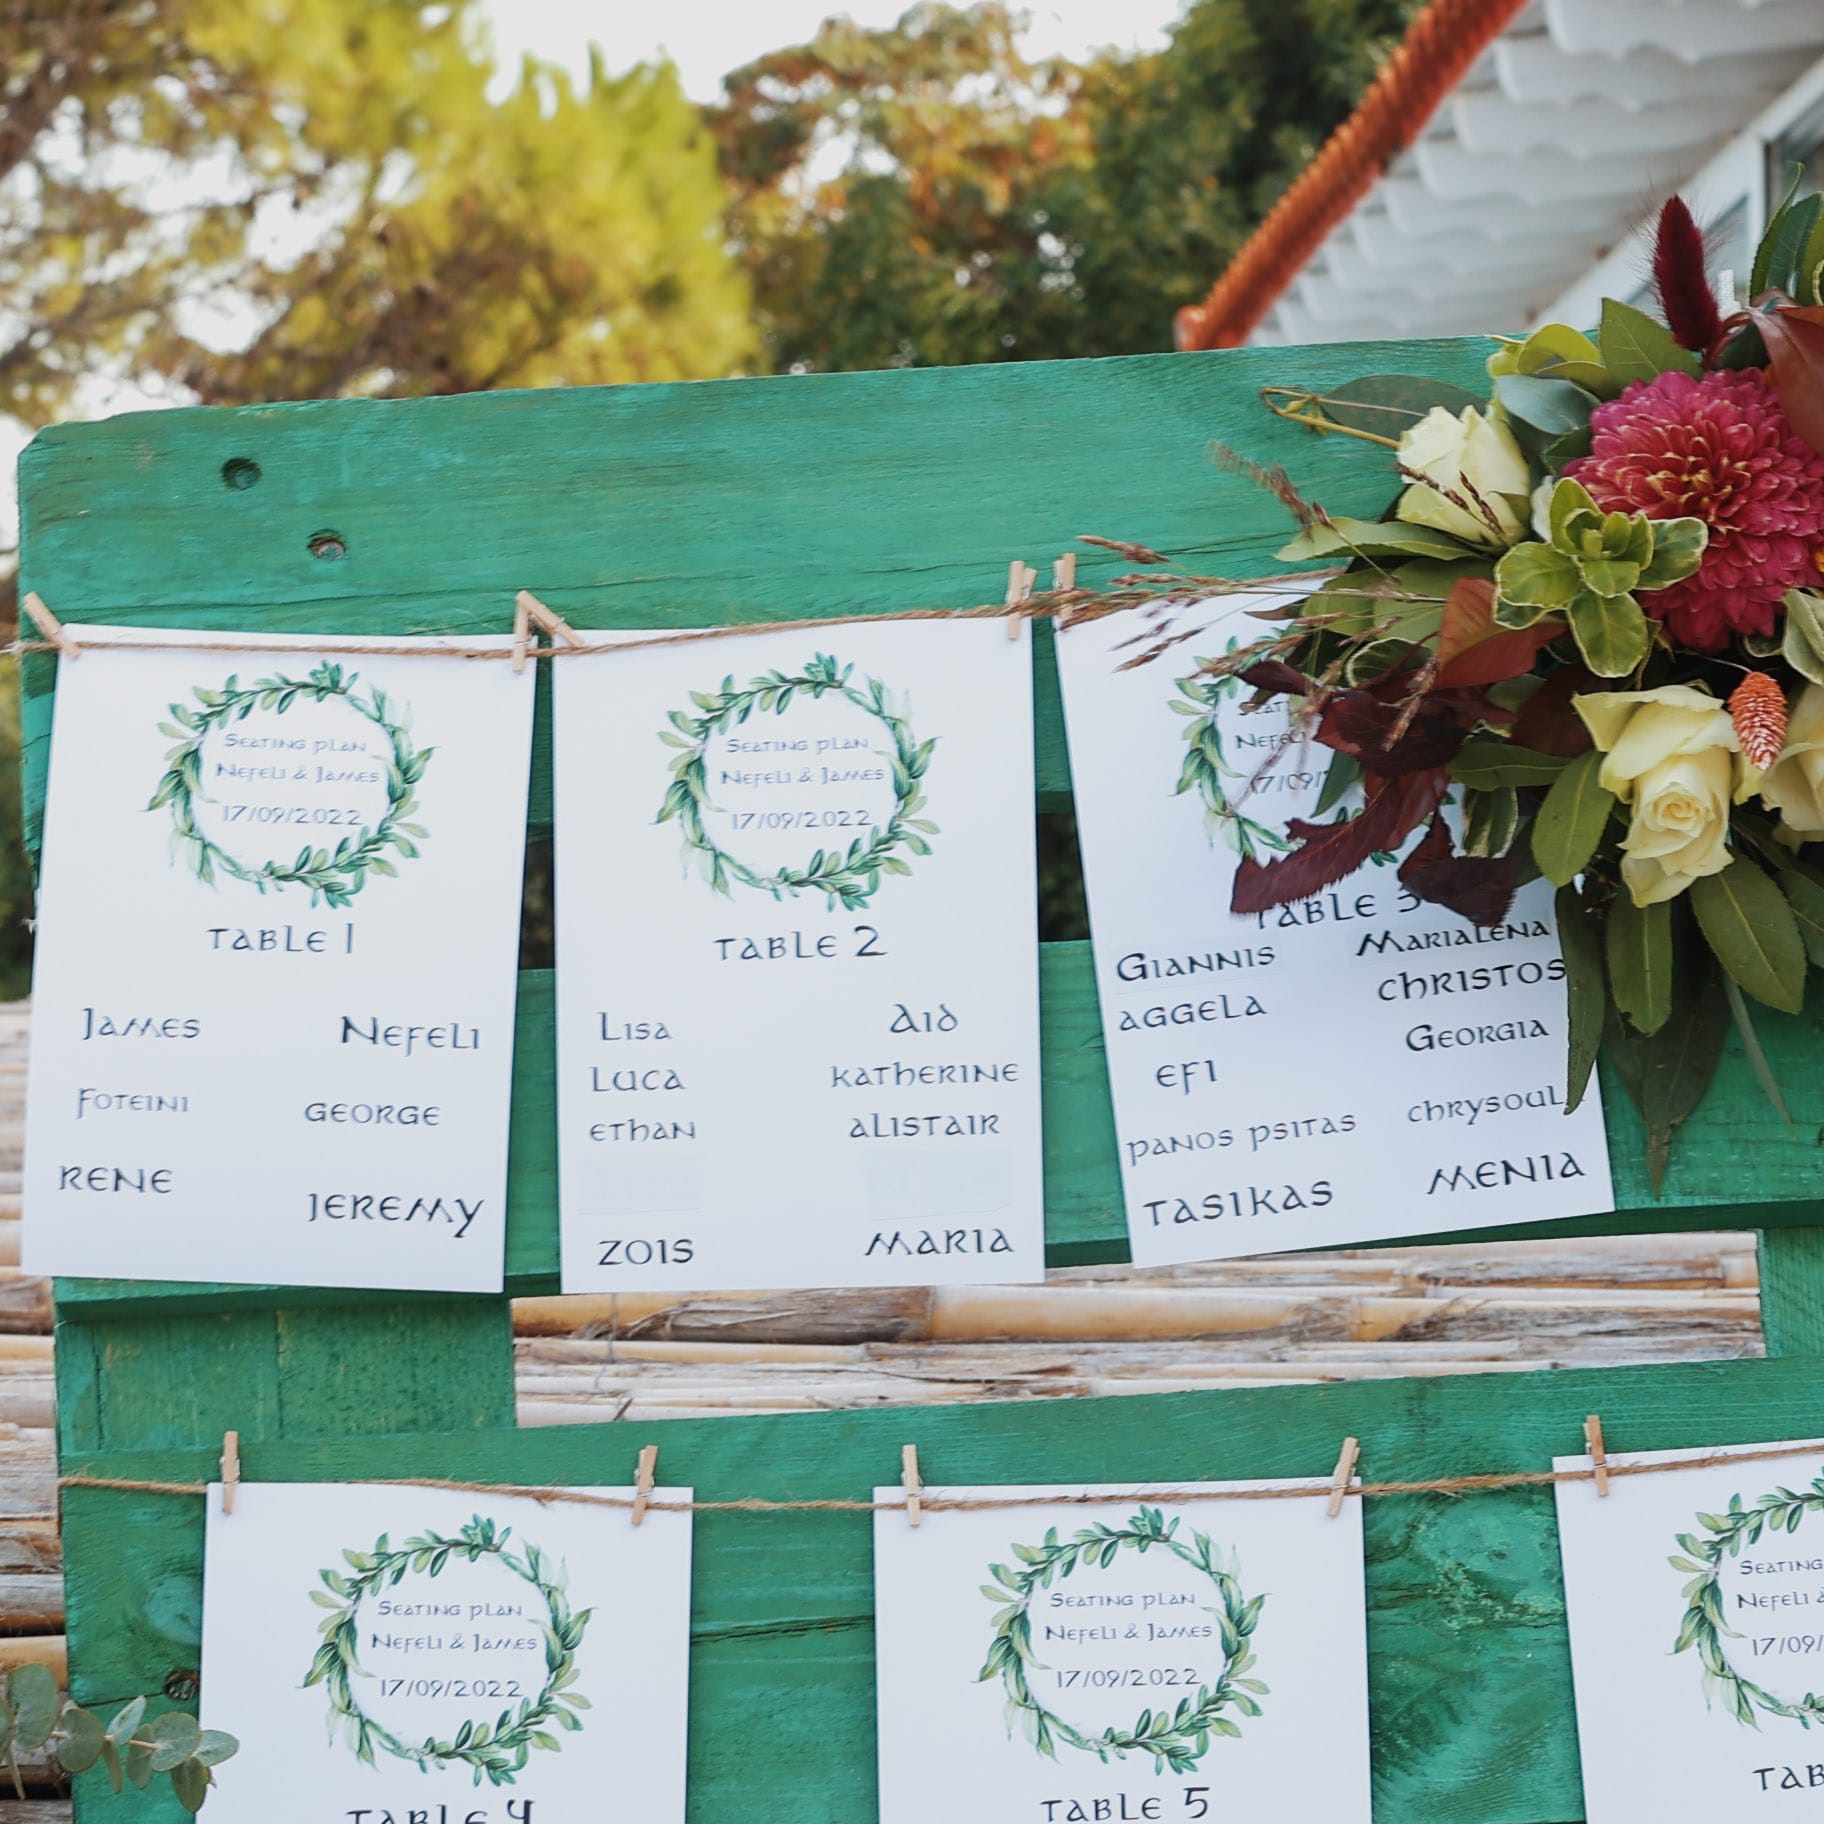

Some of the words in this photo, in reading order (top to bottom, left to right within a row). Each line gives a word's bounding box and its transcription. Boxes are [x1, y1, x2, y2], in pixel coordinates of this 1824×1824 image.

[294, 765, 310, 782] &
[800, 767, 814, 784] &
[224, 806, 363, 825] 17/09/2022
[733, 810, 872, 829] 17/09/2022
[207, 926, 325, 952] TABLE
[347, 923, 353, 954] 1
[714, 931, 836, 960] TABLE
[854, 926, 886, 957] 2
[1408, 1085, 1583, 1126] CHRYSOUL
[1124, 1623, 1139, 1639] &
[449, 1636, 464, 1649] &
[1058, 1668, 1201, 1688] 17/09/2022
[382, 1680, 523, 1698] 17/09/2022
[1040, 1793, 1160, 1822] TABLE
[1184, 1787, 1210, 1818] 5
